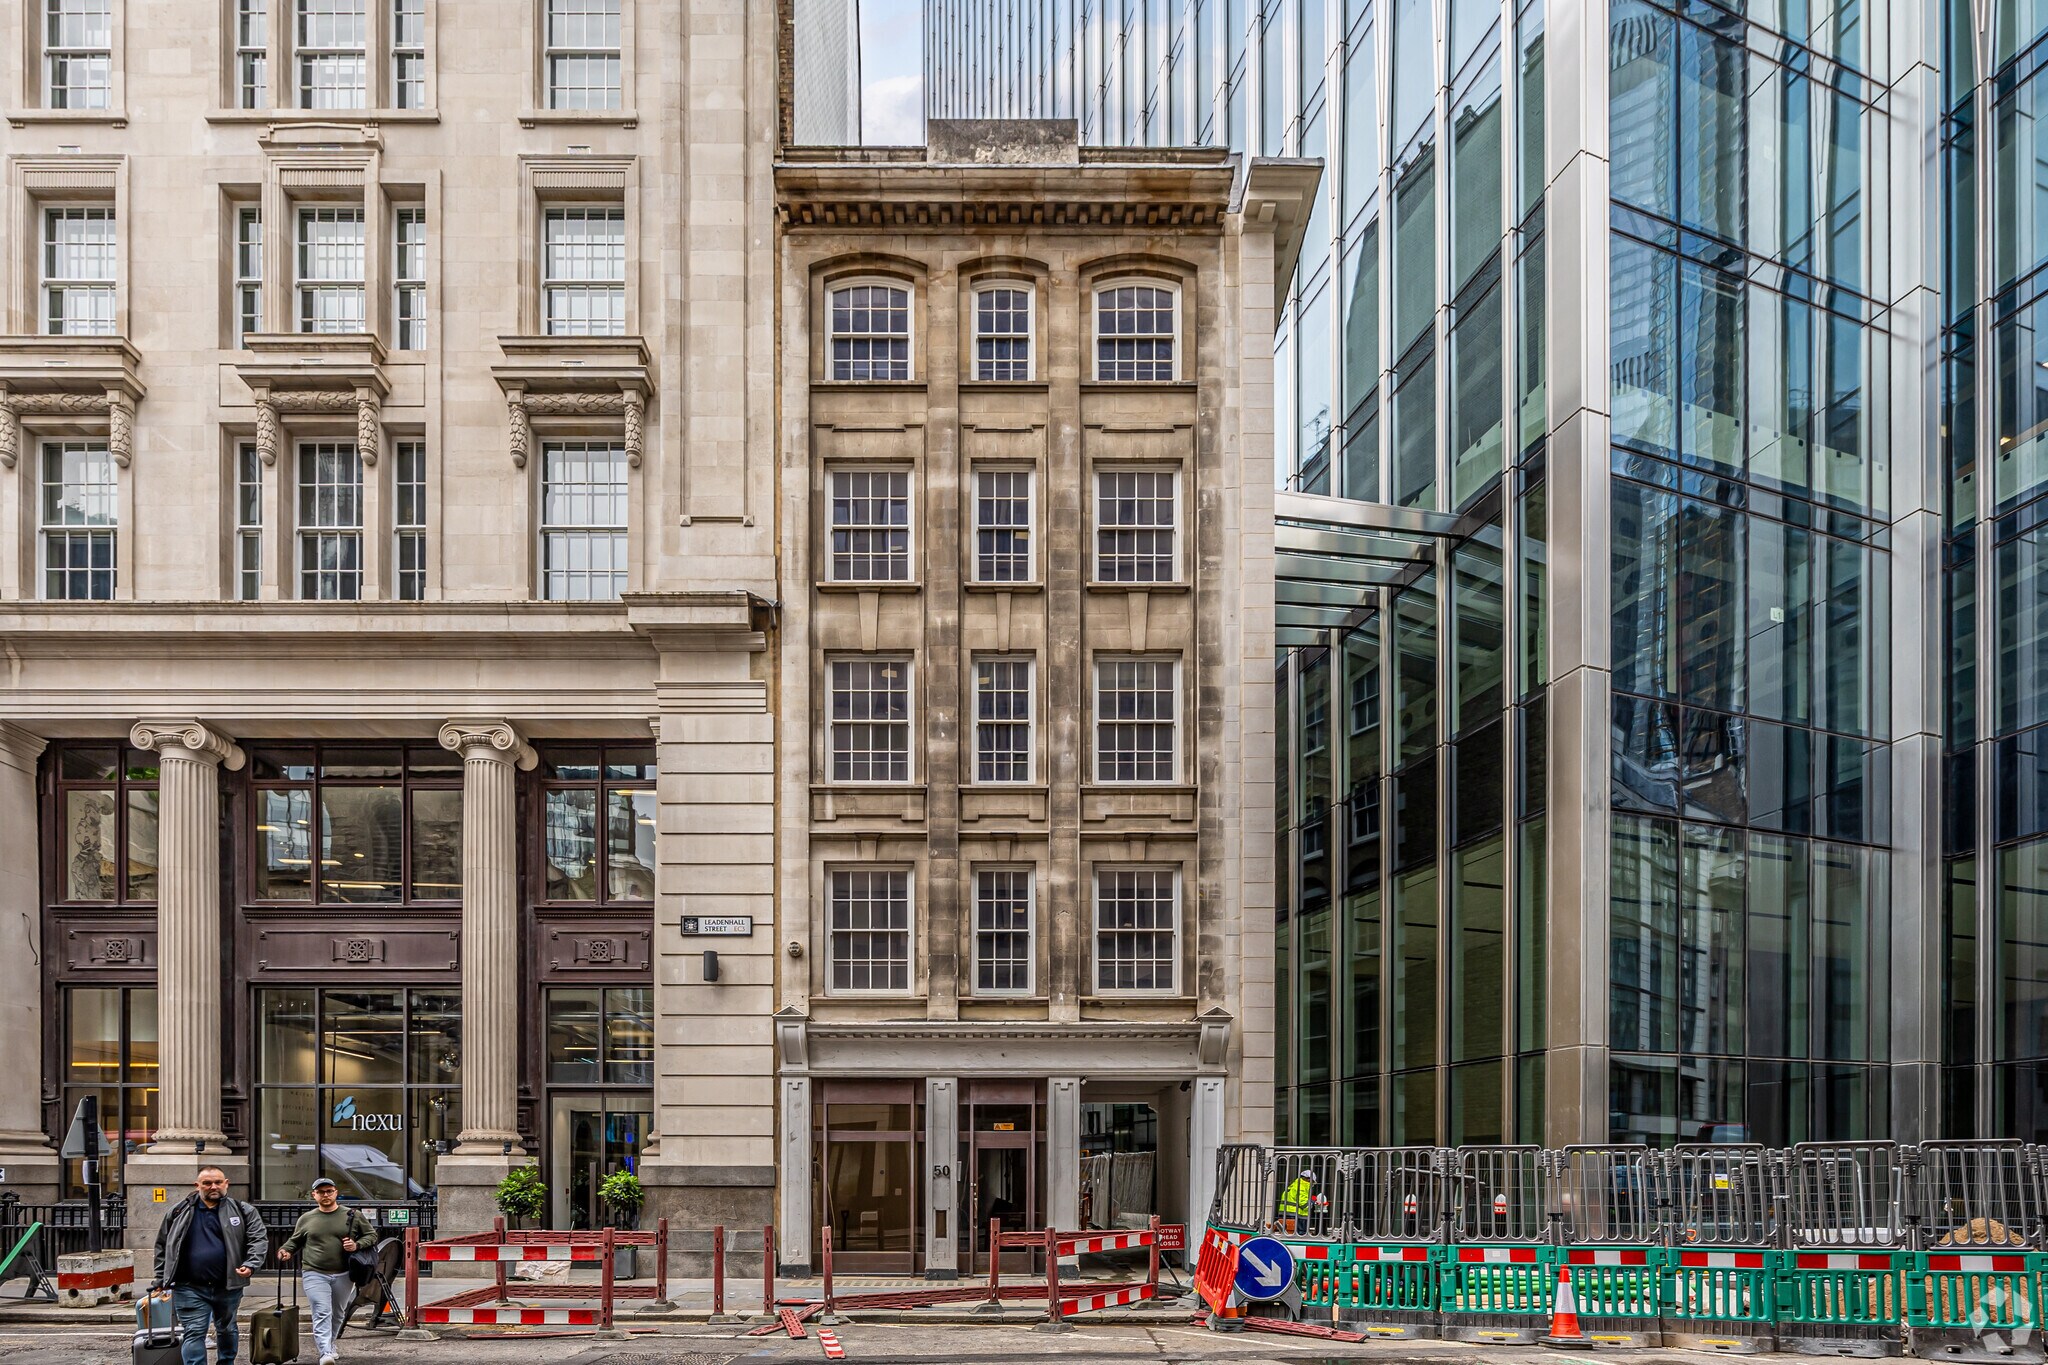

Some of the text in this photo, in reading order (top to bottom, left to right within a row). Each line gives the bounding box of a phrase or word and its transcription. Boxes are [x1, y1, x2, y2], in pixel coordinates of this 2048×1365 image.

[351, 1113, 403, 1131] nexu
[934, 1165, 950, 1176] 50
[154, 1189, 165, 1201] H
